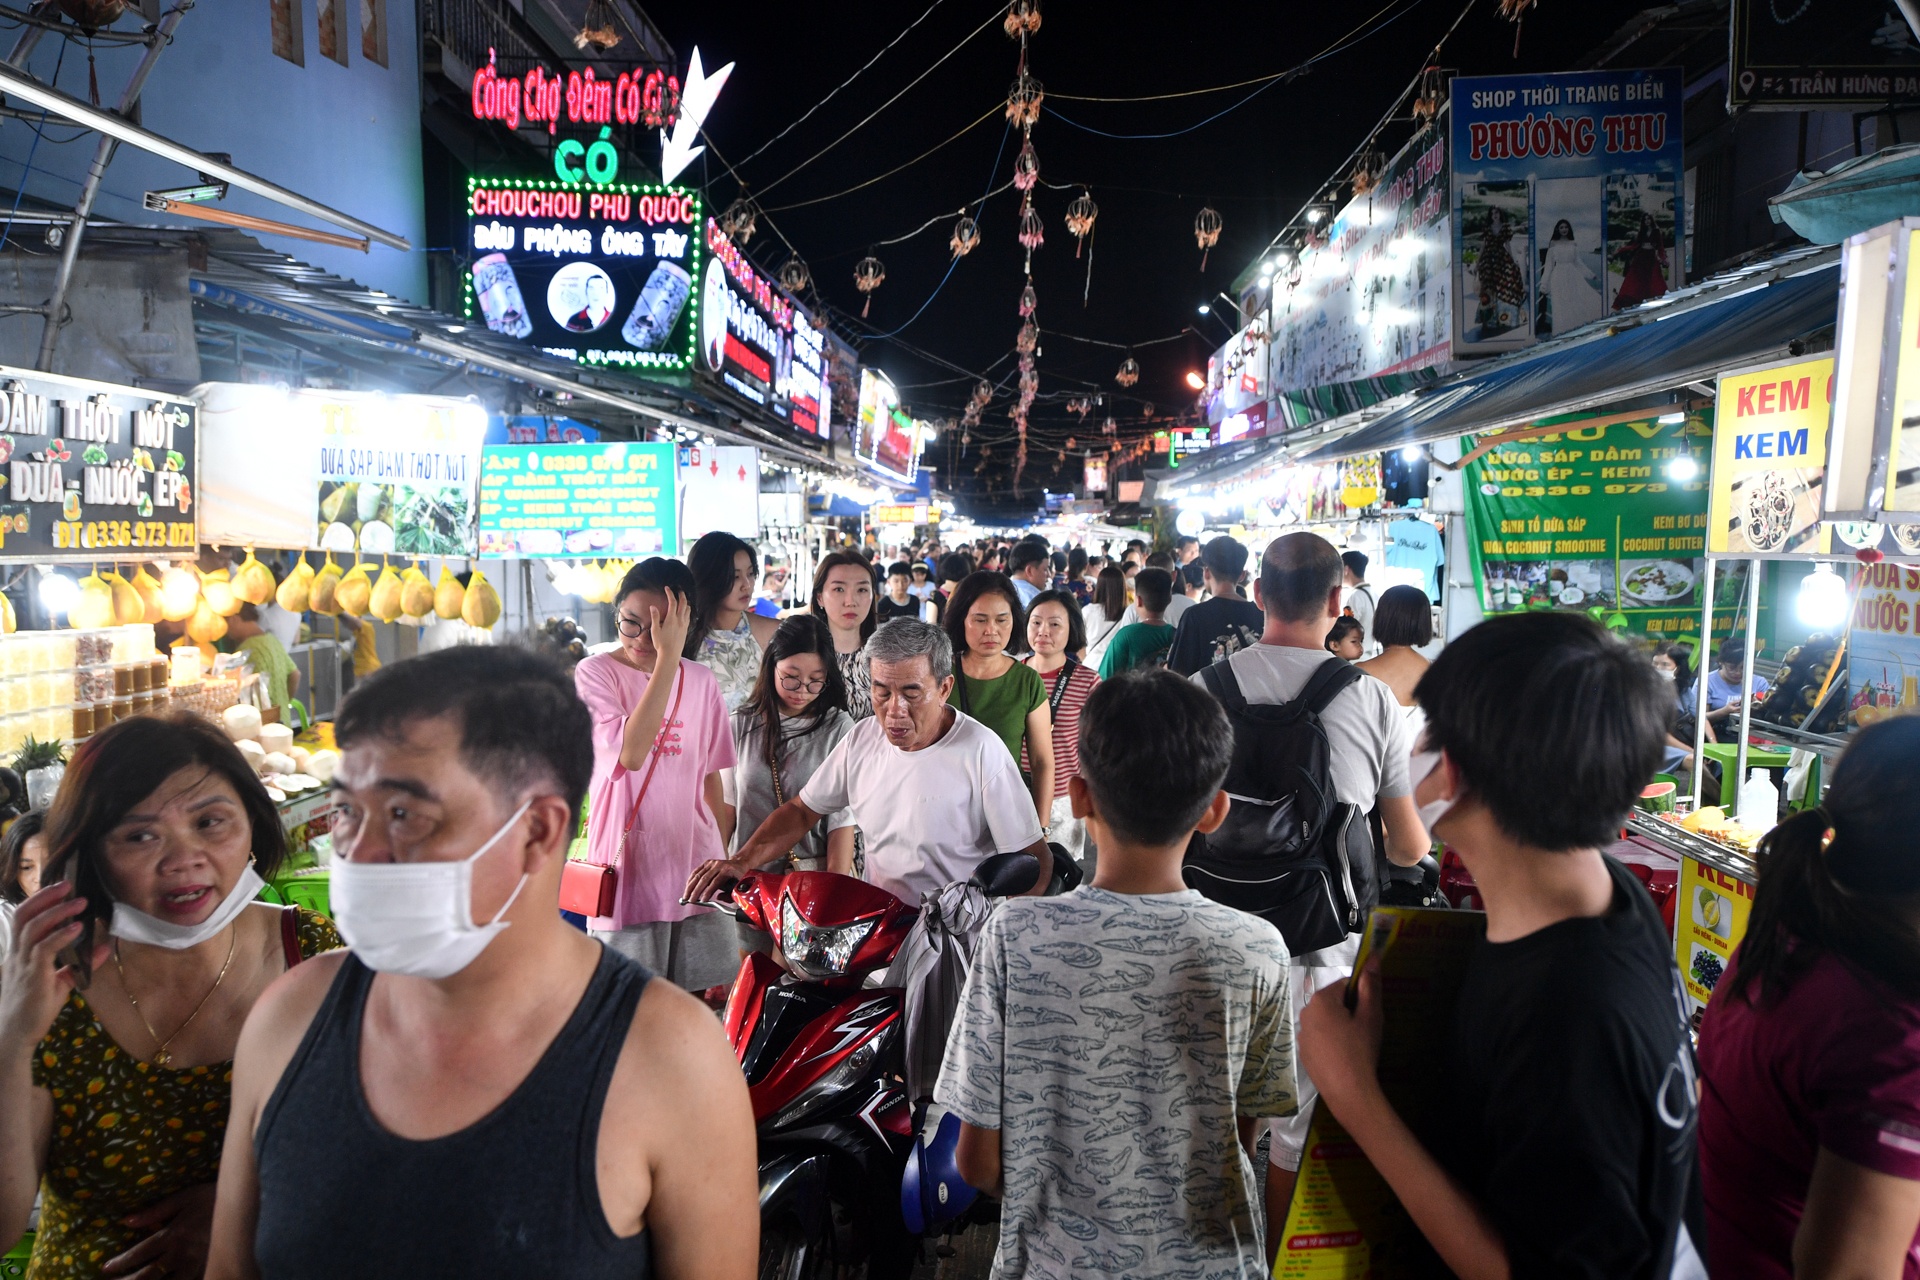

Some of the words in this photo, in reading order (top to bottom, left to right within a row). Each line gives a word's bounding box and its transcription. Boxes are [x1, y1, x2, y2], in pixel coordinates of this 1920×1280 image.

[566, 65, 612, 123] Đêm
[1472, 90, 1516, 109] SHOP
[1521, 84, 1560, 106] THỜI
[1565, 84, 1619, 104] TRANG
[1789, 70, 1836, 93] TRẦN
[1842, 74, 1889, 93] HƯNG
[1894, 77, 1920, 96] ĐẠ
[1469, 112, 1596, 161] PHƯƠNG
[1602, 112, 1667, 153] THU
[554, 125, 618, 184] CÓ
[1416, 137, 1444, 190] THU
[472, 188, 581, 219] CHOUCHOU
[601, 225, 643, 256] ÔNG
[652, 228, 688, 259] TÂY
[1737, 377, 1811, 417] KEM
[63, 393, 122, 444] THỐT
[134, 401, 178, 450] NỐT
[1540, 448, 1583, 463] SÁP
[1650, 446, 1704, 460] THT
[1735, 428, 1808, 459] KEM
[84, 459, 146, 506] NƯỚC
[154, 464, 181, 507] ÉP
[1481, 468, 1539, 482] NƯỚC
[1547, 467, 1574, 481] ÉP
[1602, 466, 1651, 479] KEM
[1502, 485, 1591, 497] 0336
[1605, 483, 1667, 494] 973
[1682, 481, 1710, 492] 0
[57, 521, 83, 549] ĐT
[85, 520, 131, 549] 0336
[133, 520, 167, 548] 973
[169, 522, 195, 548] 071
[1501, 519, 1525, 533] SINH
[1567, 515, 1587, 532] SÁP
[1653, 515, 1675, 530] KEM
[1505, 540, 1552, 554] COCONUT
[1555, 539, 1606, 553] SMOOTHIE
[1623, 537, 1666, 552] COCONUT
[1668, 536, 1703, 550] BUTTER
[1906, 563, 1920, 593] S
[1853, 593, 1909, 635] NƯỚC
[778, 990, 807, 1004] HONDA
[877, 1093, 906, 1114] HONDA
